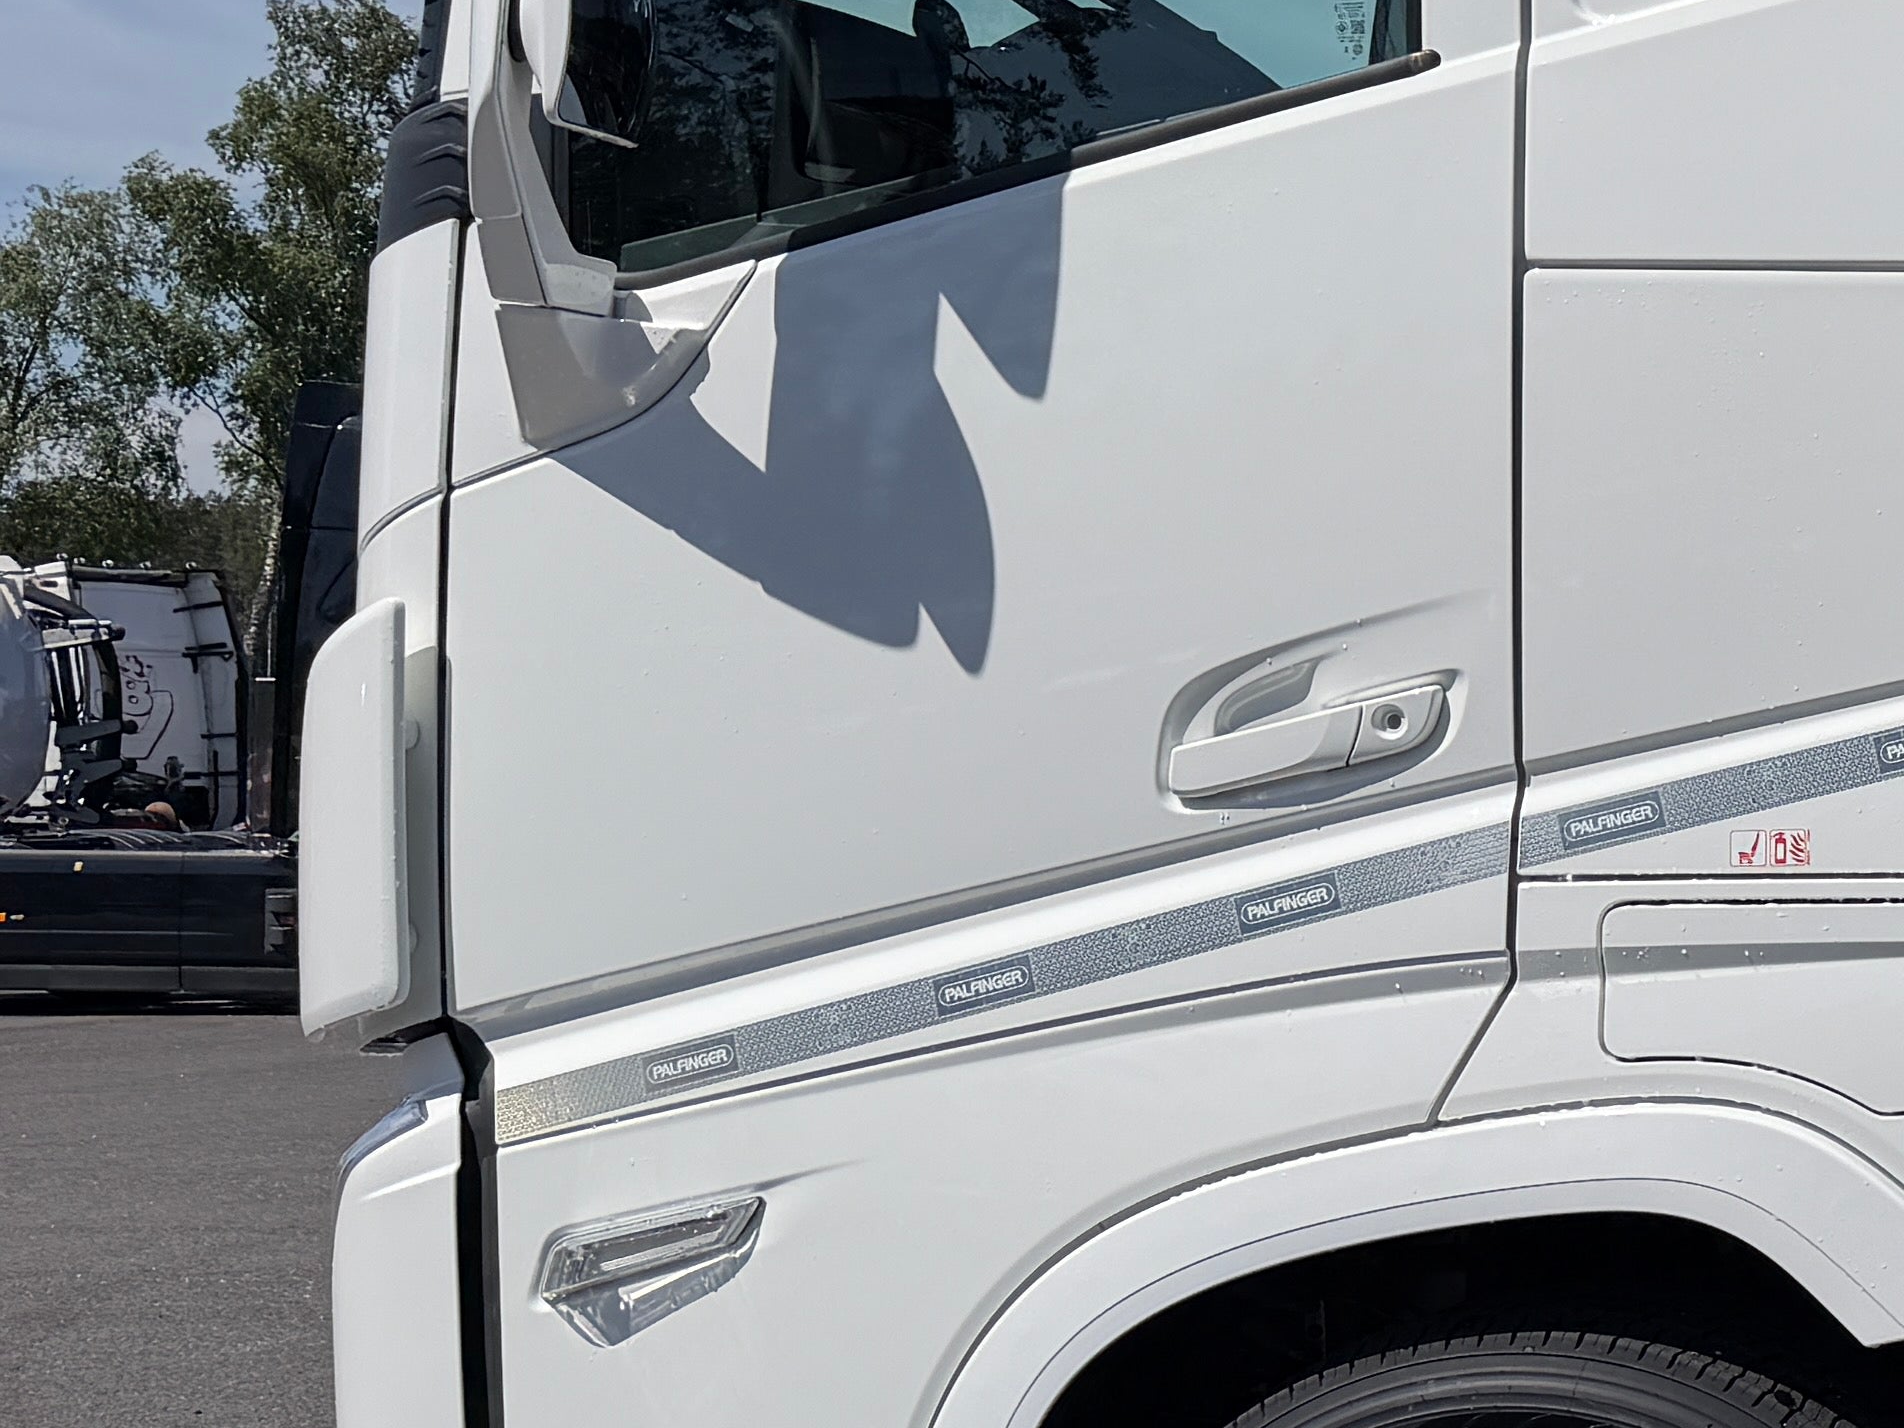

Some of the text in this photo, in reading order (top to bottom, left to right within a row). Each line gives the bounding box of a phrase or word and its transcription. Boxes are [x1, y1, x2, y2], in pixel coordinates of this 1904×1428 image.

[1570, 803, 1653, 840] PALFINGER
[1246, 886, 1330, 920] PALFINGER
[944, 970, 1023, 1005] PALFINGER
[651, 1047, 728, 1081] PALFINGER
